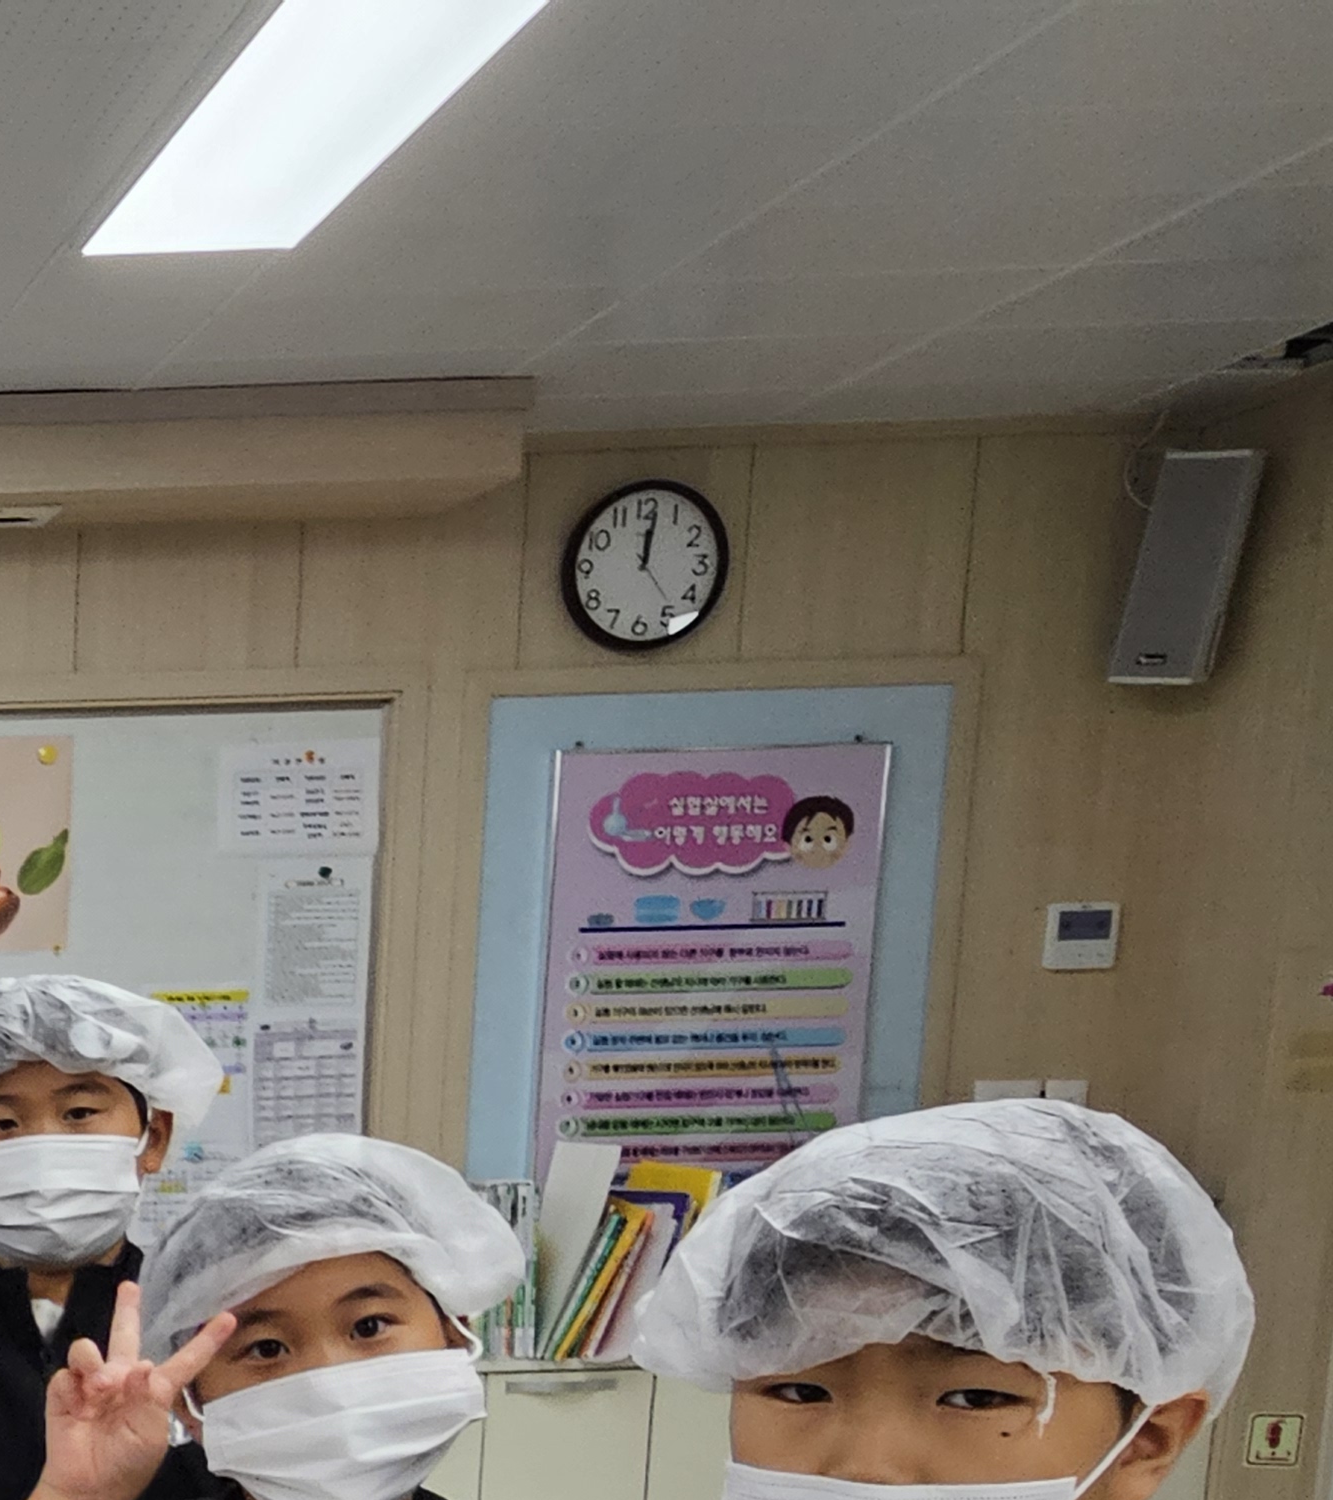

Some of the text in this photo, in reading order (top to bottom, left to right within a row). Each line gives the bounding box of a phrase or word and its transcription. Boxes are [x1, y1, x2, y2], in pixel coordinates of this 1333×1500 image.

[612, 505, 628, 528] 11
[636, 497, 658, 520] 12
[672, 503, 679, 525] 1
[588, 529, 611, 551] 10
[686, 524, 702, 547] 2
[577, 558, 594, 579] 9
[691, 554, 709, 576] 3
[585, 589, 601, 610] 8
[681, 583, 696, 604] 4
[606, 608, 620, 629] 7
[631, 614, 648, 635] 6
